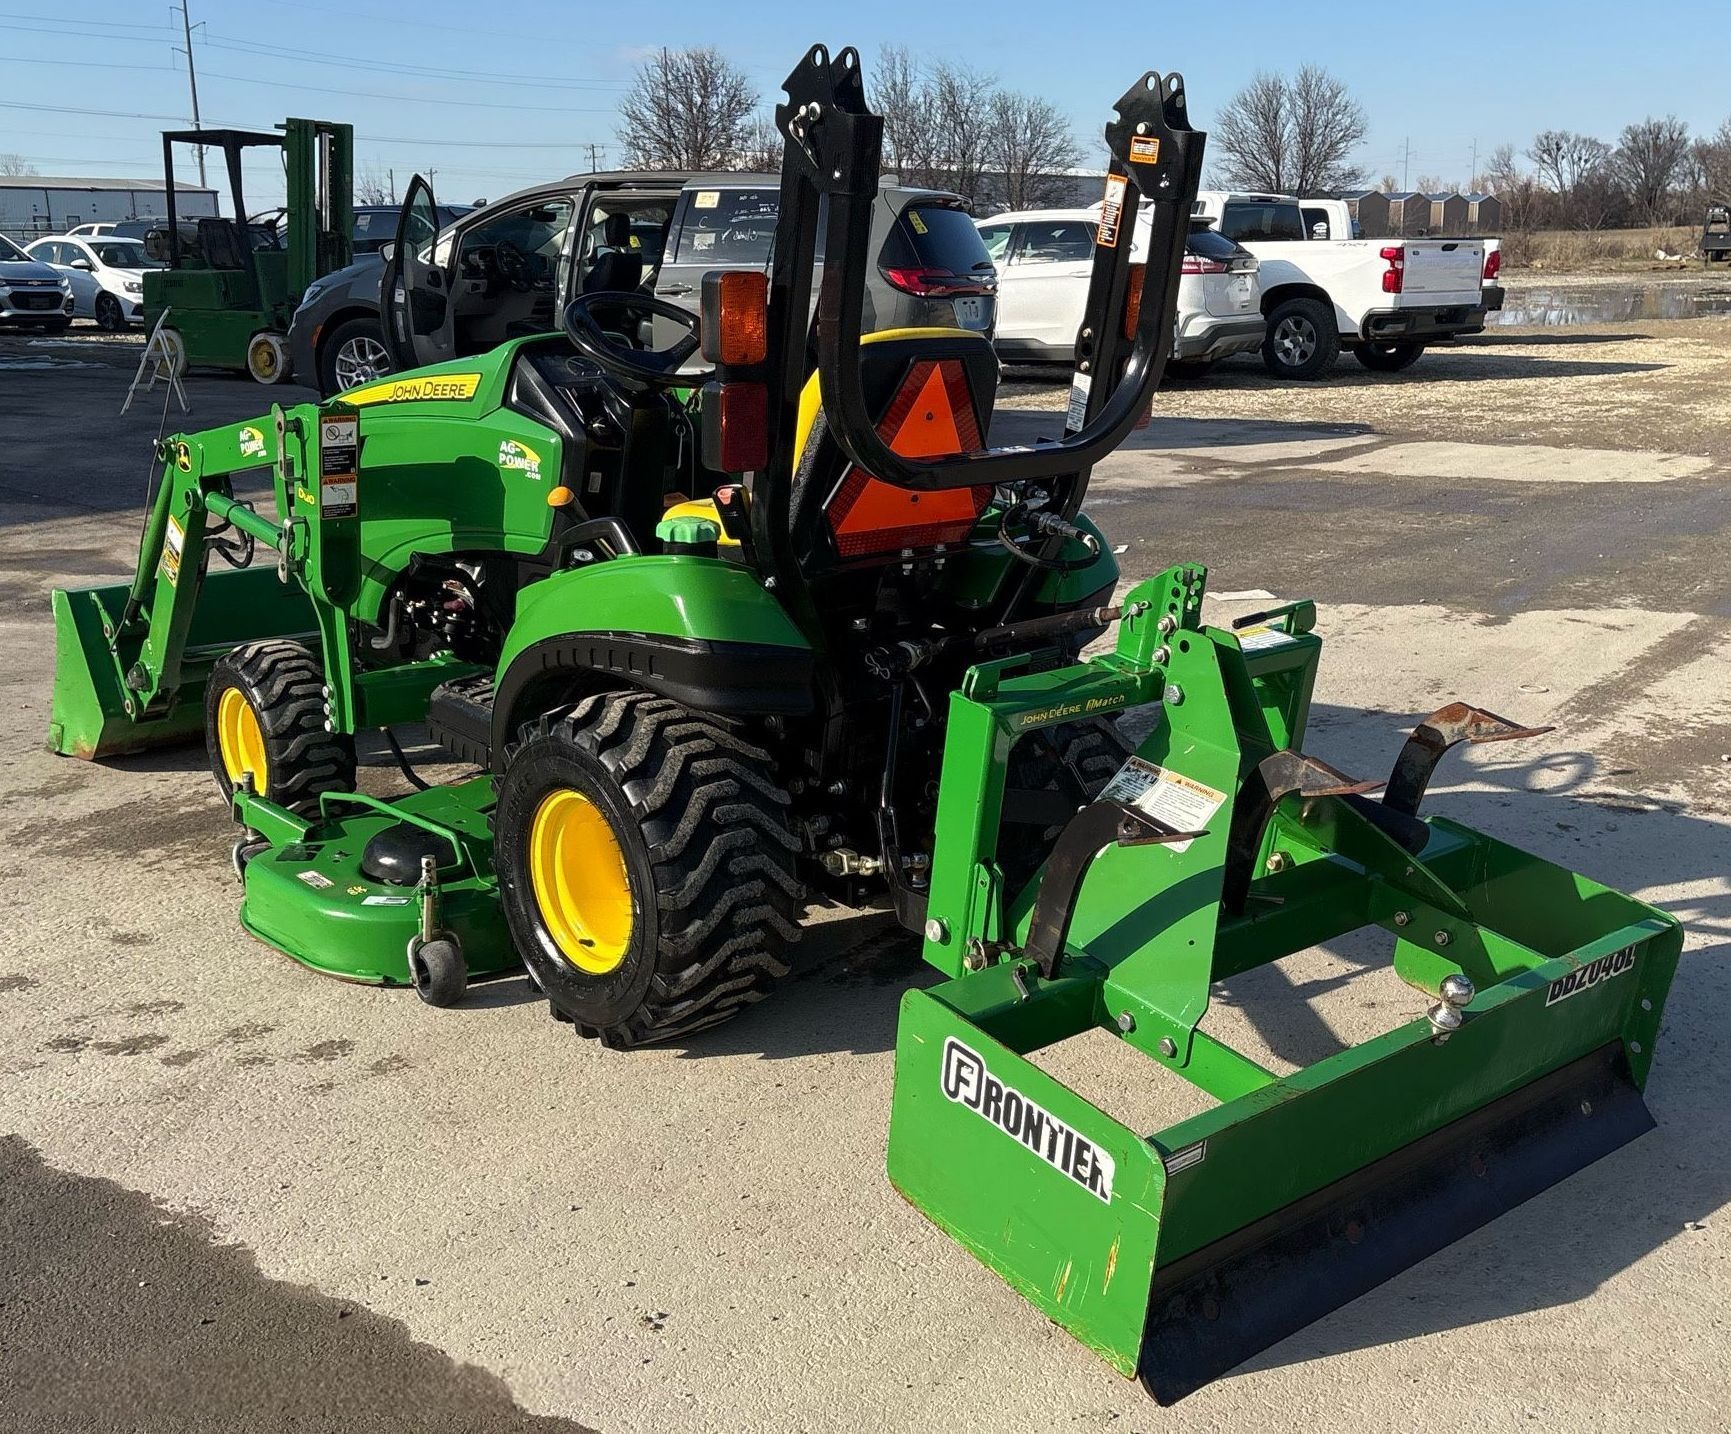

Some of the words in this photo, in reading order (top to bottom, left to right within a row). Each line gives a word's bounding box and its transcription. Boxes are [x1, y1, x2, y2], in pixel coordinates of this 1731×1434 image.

[389, 382, 422, 401] JOHN
[422, 381, 469, 398] DEERE
[499, 440, 522, 454] AG-
[498, 452, 540, 473] POWER
[1020, 711, 1048, 726] JOHN
[1048, 702, 1082, 719] DEERE
[1184, 780, 1215, 798] WARNING
